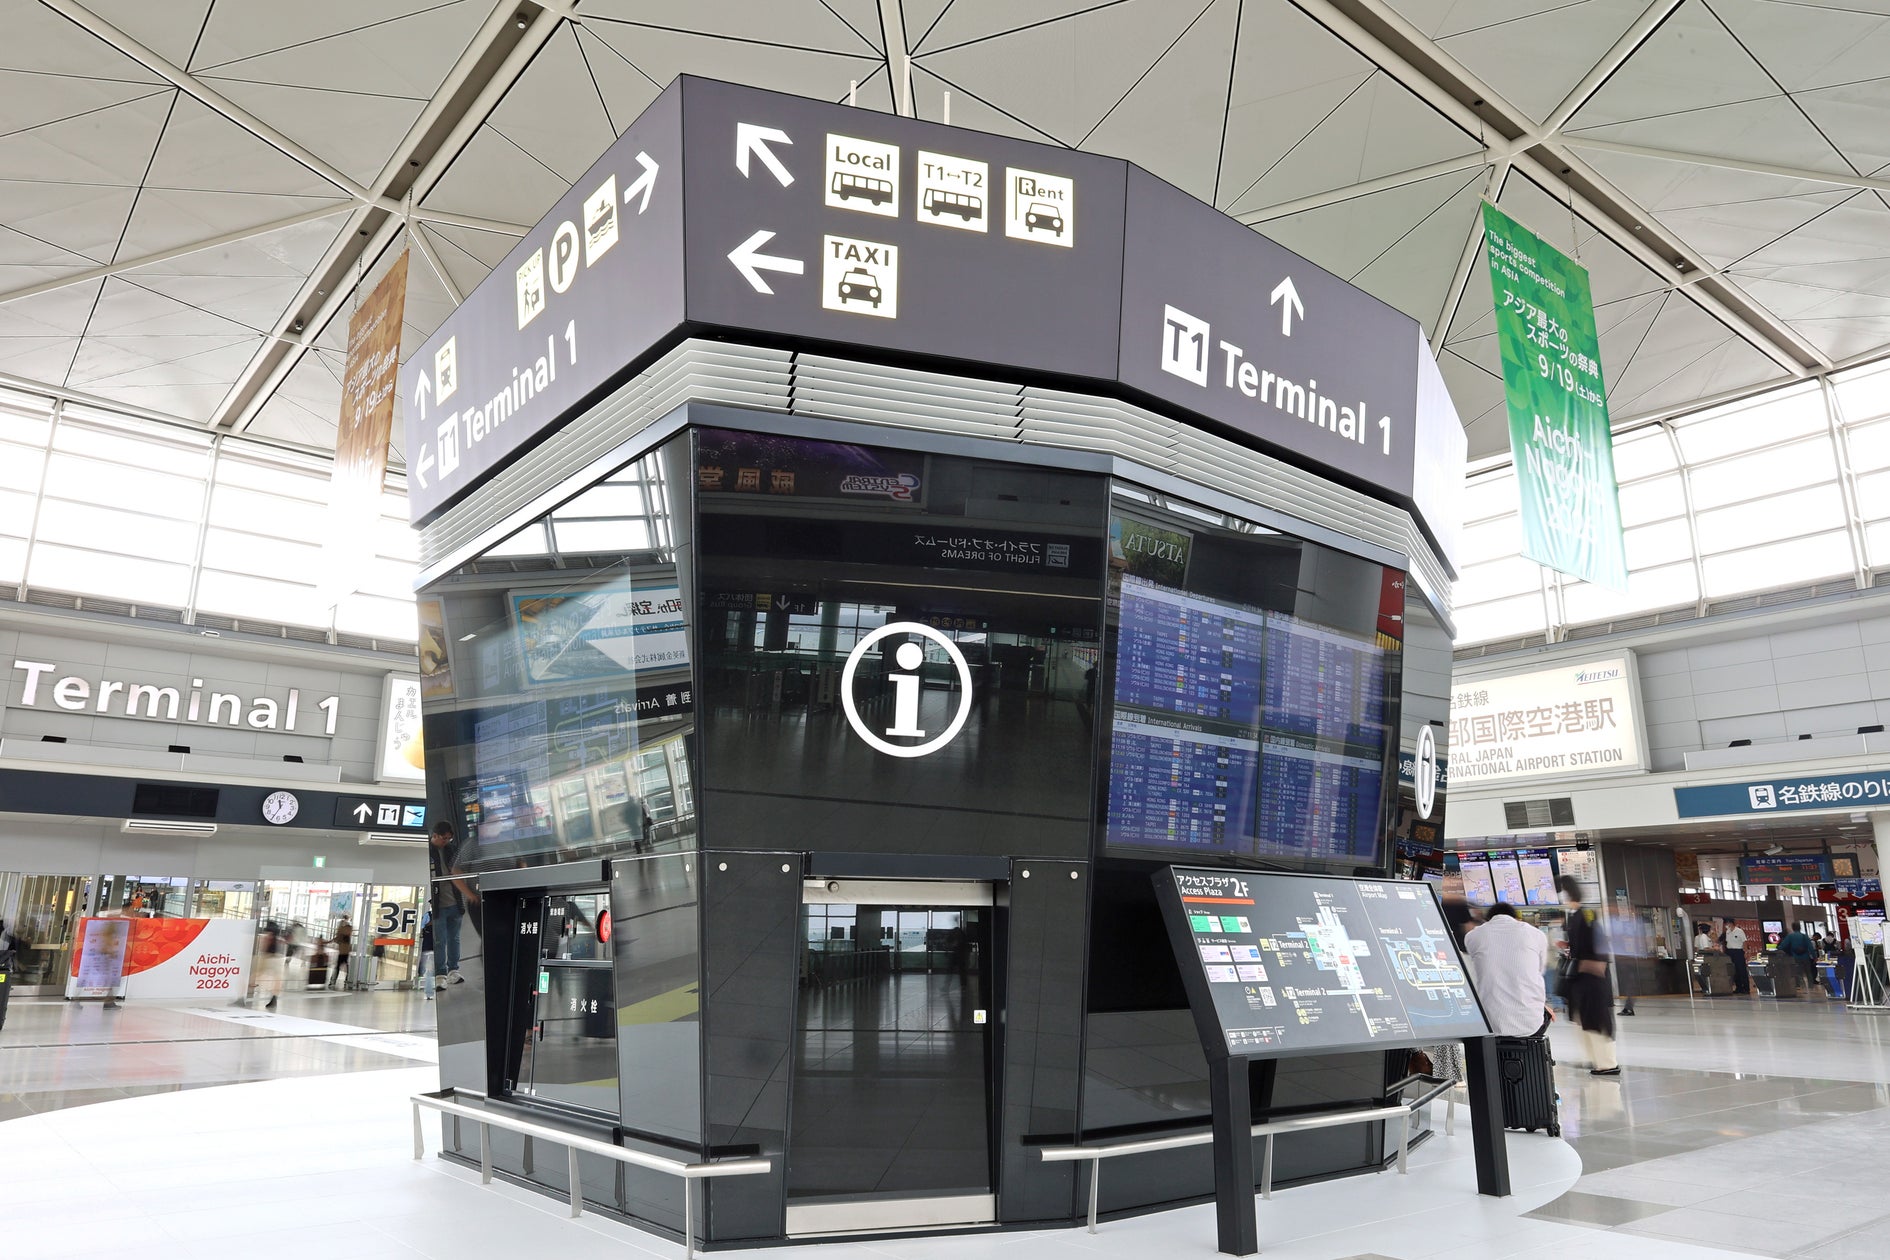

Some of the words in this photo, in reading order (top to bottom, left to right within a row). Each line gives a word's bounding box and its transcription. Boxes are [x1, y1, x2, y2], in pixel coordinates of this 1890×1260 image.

[835, 146, 891, 171] Local
[924, 163, 944, 181] T1
[961, 170, 983, 188] T2
[1018, 177, 1064, 200] Rent
[533, 252, 542, 269] UP
[831, 241, 889, 267] TAXI
[1489, 230, 1504, 246] The
[1505, 239, 1537, 268] biggest
[1490, 244, 1517, 268] sports
[1519, 263, 1566, 299] competition
[1491, 256, 1499, 271] in
[1501, 266, 1520, 284] ASIA
[1503, 289, 1568, 342] アジア最大の
[1167, 319, 1203, 371] T1
[1526, 323, 1600, 379] スポーツの祭典
[462, 334, 556, 449] Terminal
[564, 319, 577, 366] 1
[1219, 341, 1366, 445] Terminal
[1378, 415, 1391, 455] 1
[440, 424, 458, 470] T1
[1155, 583, 1188, 597] International
[1189, 591, 1216, 604] Departures
[14, 660, 298, 731] Terminal
[318, 696, 340, 735] 1
[1148, 717, 1181, 728] International
[1183, 722, 1203, 731] Arrivals
[1295, 741, 1315, 750] Domestic
[1475, 747, 1514, 763] JAPAN
[1515, 755, 1566, 771] AIRPORT
[1570, 748, 1623, 766] STATION
[380, 808, 397, 821] T1
[1177, 875, 1229, 887] アクセスプラザ
[1230, 878, 1249, 897] 2F
[1182, 886, 1204, 896] Access
[1204, 887, 1223, 896] Plaza
[1362, 892, 1376, 900] Airport
[377, 902, 416, 934] 3F
[1838, 907, 1848, 921] 3
[1278, 940, 1304, 949] Terminal
[1304, 941, 1309, 949] 2
[189, 965, 240, 977] Nagoya
[197, 954, 236, 965] Aichi-
[196, 979, 230, 989] 2026
[1295, 988, 1321, 996] Terminal
[1322, 988, 1327, 996] 2
